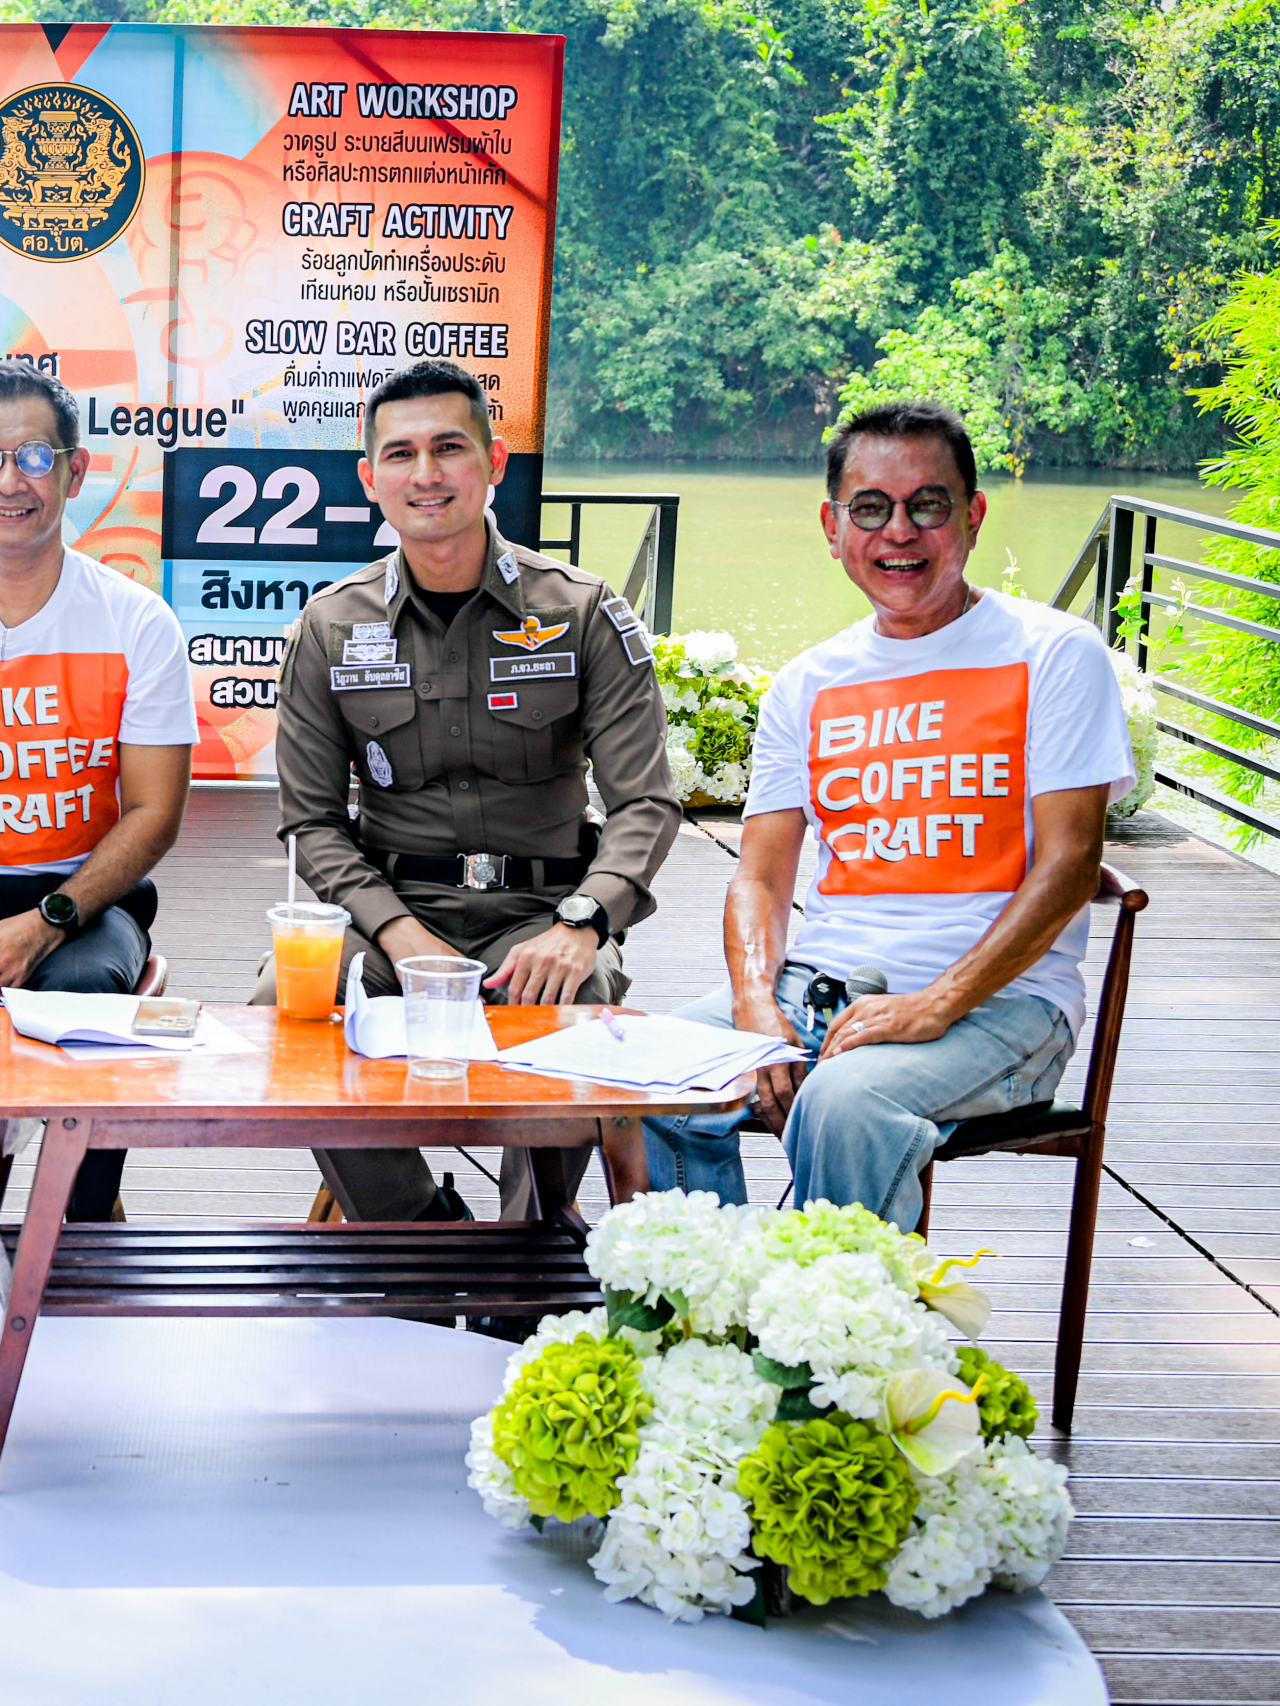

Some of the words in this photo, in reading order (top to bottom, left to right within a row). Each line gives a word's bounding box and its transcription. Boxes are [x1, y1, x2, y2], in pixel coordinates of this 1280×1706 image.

[288, 82, 348, 117] ART
[356, 82, 518, 120] WORKSHOP
[283, 131, 337, 158] วาดรูป
[344, 129, 512, 155] ระบายสีบนเฟรมผ้าใบ
[283, 160, 506, 186] หรือศิลปะการตกแต่งหน้าเค้ก
[282, 202, 375, 237] CRAFT
[382, 204, 514, 240] ACTIVITY
[22, 234, 89, 252] ศอ.บต.
[301, 245, 506, 277] ร้อยลูกปัดทำเครื่องประดับ
[301, 280, 376, 301] เทียนหอม
[384, 275, 500, 303] หรือปั้นเซรามิก
[246, 319, 328, 355] SLOW
[336, 321, 396, 356] BAR
[405, 323, 508, 358] COFFEE
[88, 397, 245, 448] League"
[817, 700, 946, 759] BIKE
[817, 753, 1010, 812] COFFEE
[826, 813, 985, 863] CRAFT
